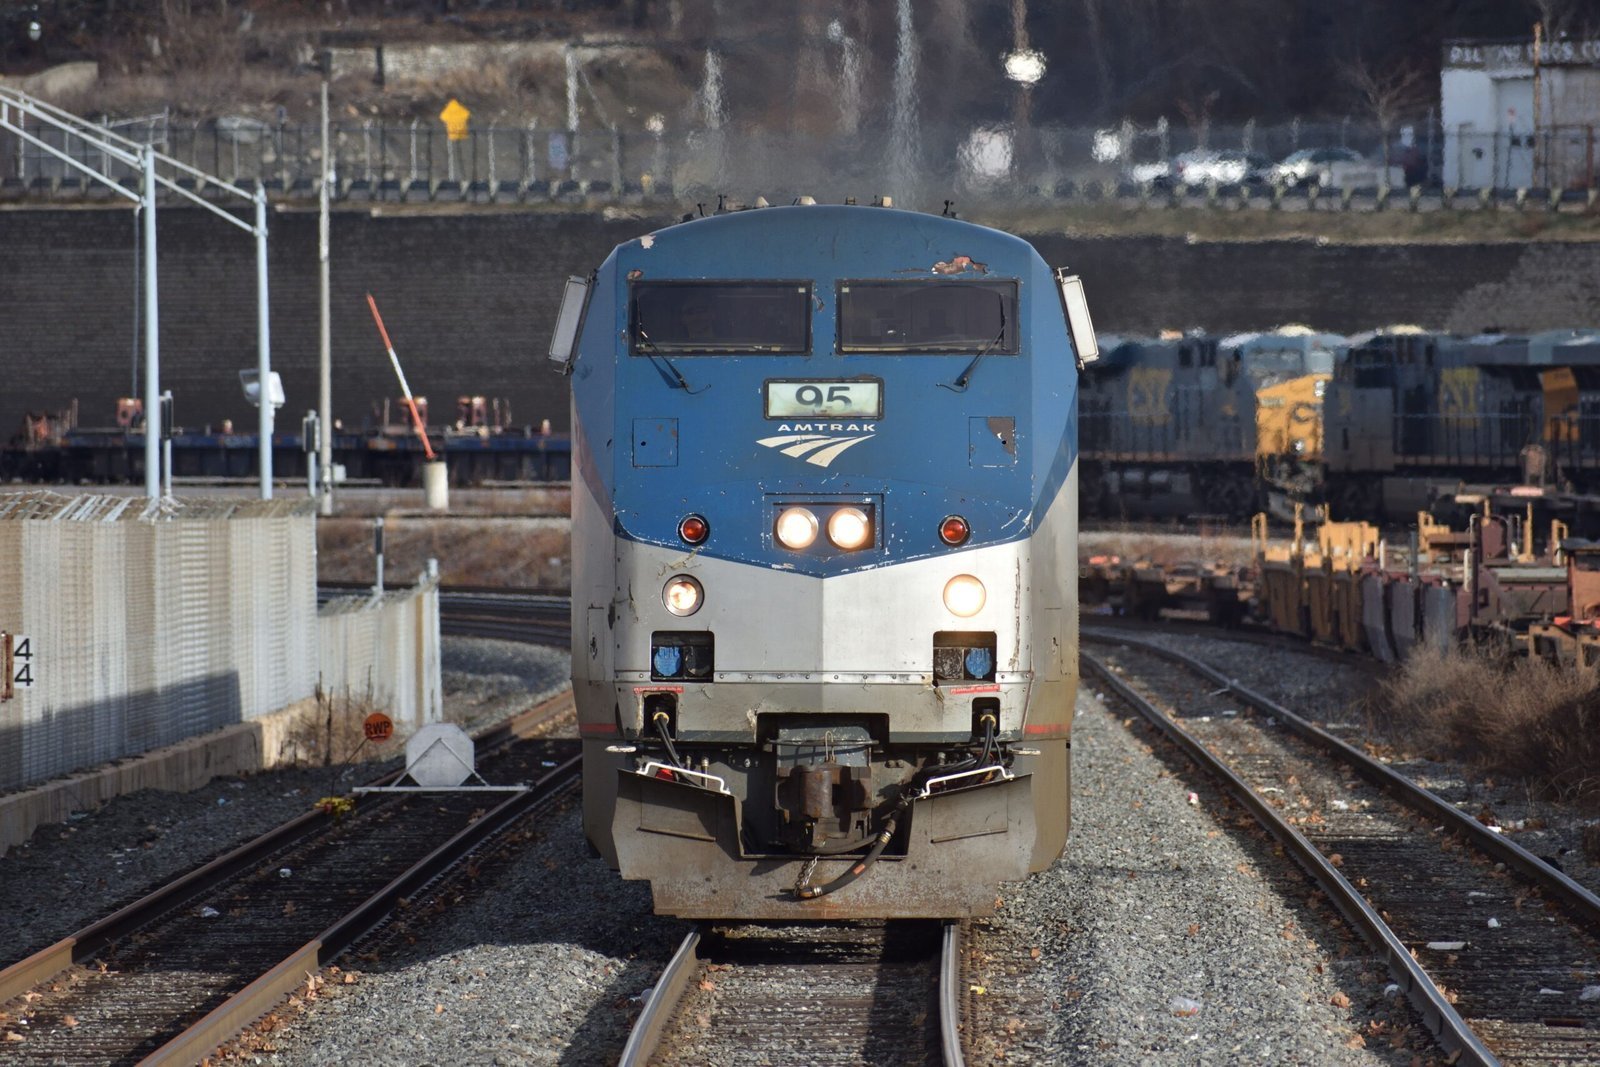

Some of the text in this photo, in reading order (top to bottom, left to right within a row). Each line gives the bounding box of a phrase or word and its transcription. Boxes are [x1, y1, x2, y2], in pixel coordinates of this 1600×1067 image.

[795, 385, 852, 409] 95
[777, 423, 876, 432] AMTRAK
[364, 721, 390, 736] RWP
